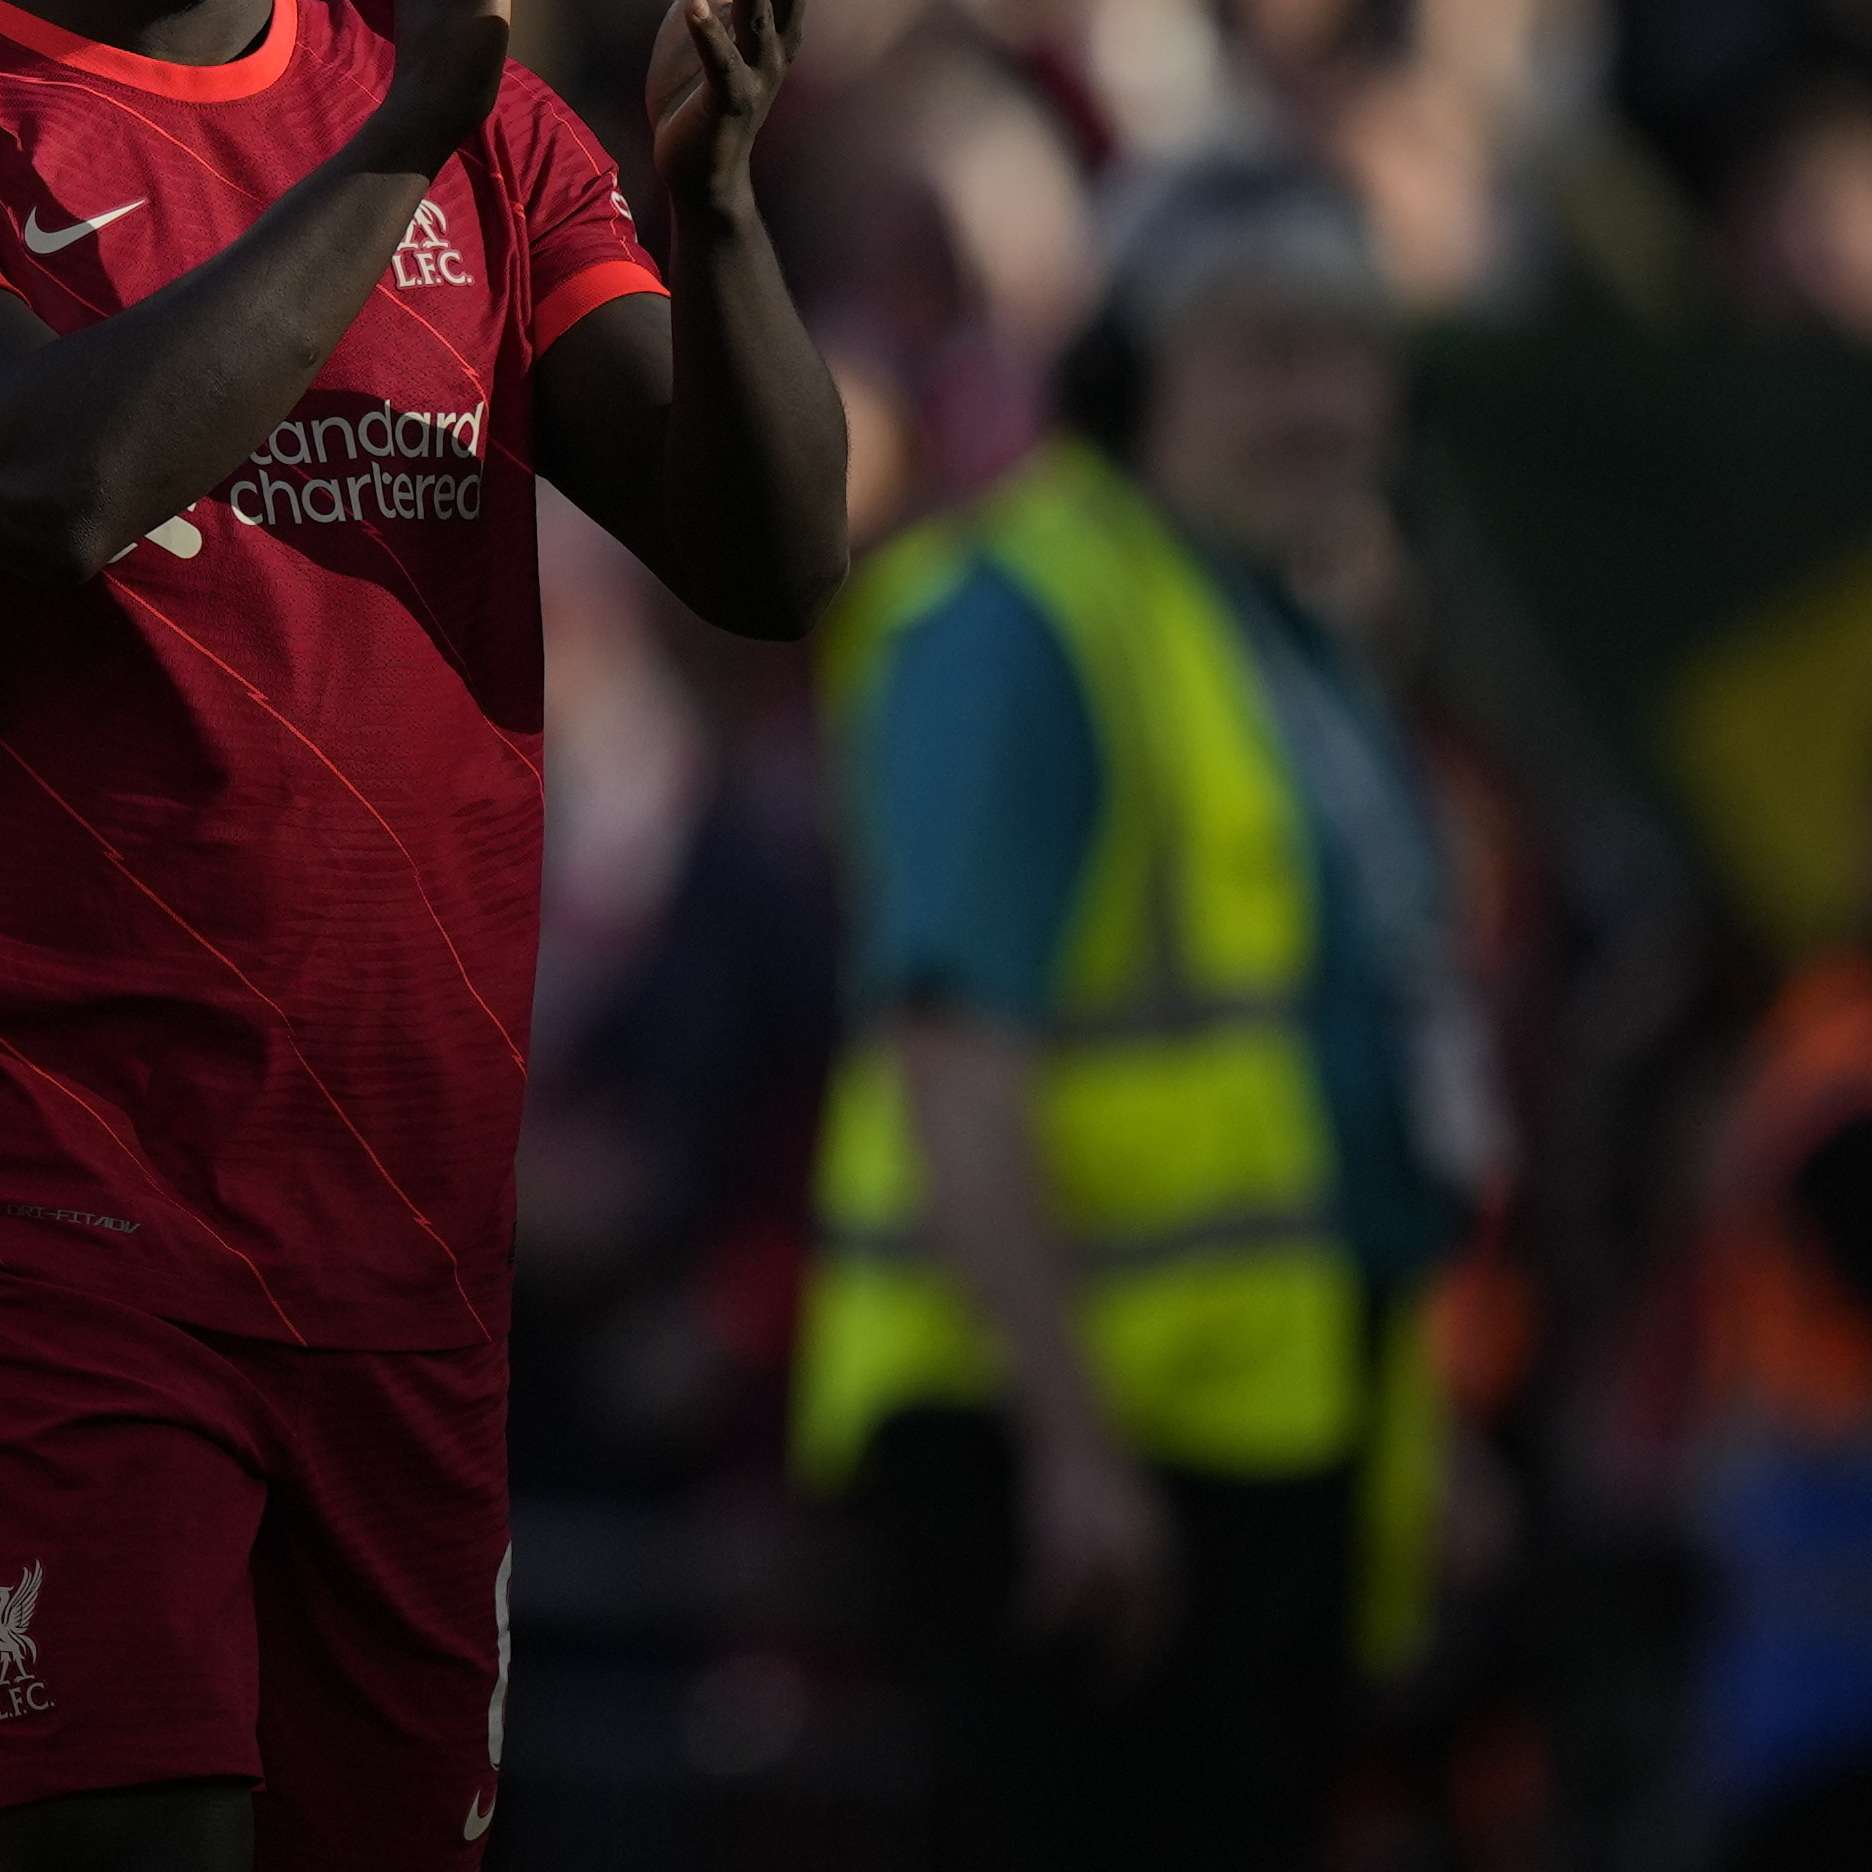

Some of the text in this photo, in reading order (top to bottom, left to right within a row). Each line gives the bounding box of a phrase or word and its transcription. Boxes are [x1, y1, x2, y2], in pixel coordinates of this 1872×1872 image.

[392, 252, 473, 288] L.F.C.
[250, 399, 484, 466] andard
[230, 460, 485, 526] chartered
